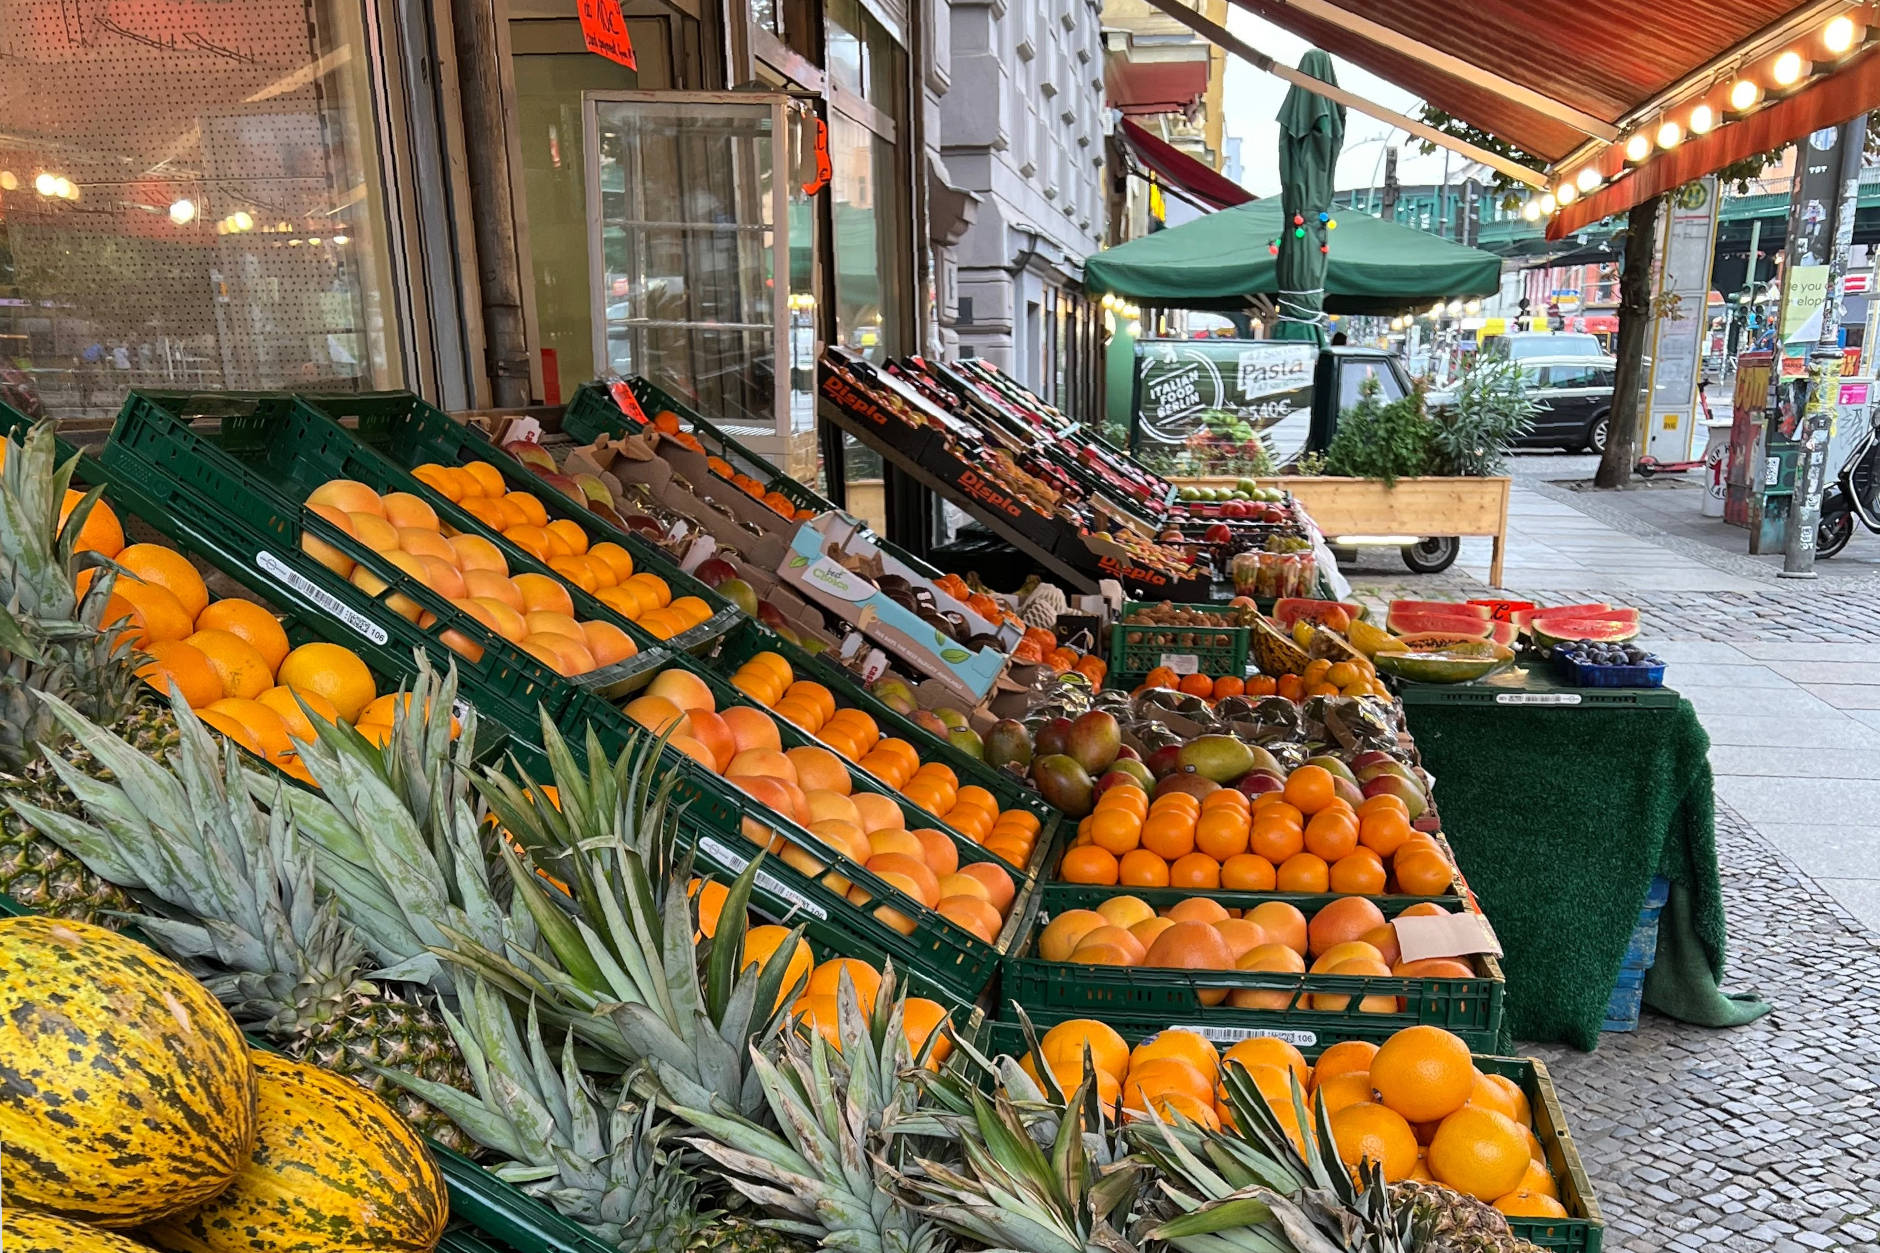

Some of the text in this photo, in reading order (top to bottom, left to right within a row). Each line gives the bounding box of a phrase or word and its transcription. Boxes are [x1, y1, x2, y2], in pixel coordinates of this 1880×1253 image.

[1801, 282, 1822, 294] you
[1149, 369, 1200, 400] ITALIAN
[1242, 360, 1303, 387] Pasta
[821, 375, 888, 426] Displa
[1156, 391, 1200, 418] BERLIN
[1159, 383, 1195, 406] FOOD
[957, 469, 1023, 517] Displa
[370, 627, 386, 642] 106
[1297, 1034, 1313, 1044] 106
